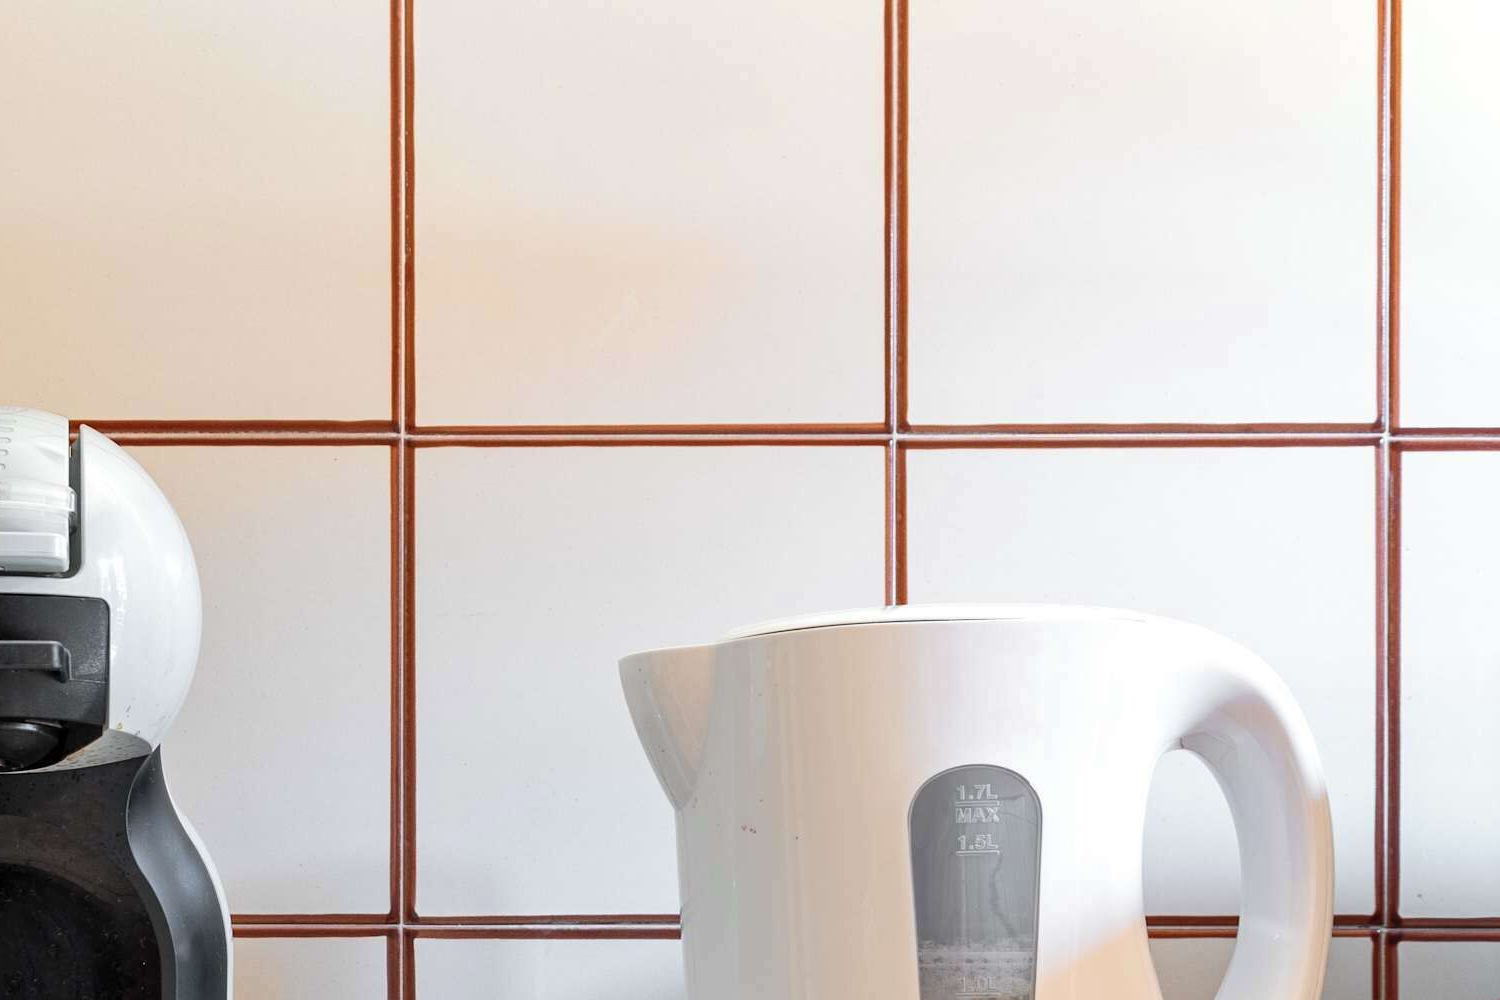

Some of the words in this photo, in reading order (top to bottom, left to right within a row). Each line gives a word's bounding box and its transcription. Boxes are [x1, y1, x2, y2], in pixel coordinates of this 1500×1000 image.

[956, 784, 998, 800] 1.7L
[956, 807, 1000, 824] MAX
[957, 834, 998, 850] 1.5L
